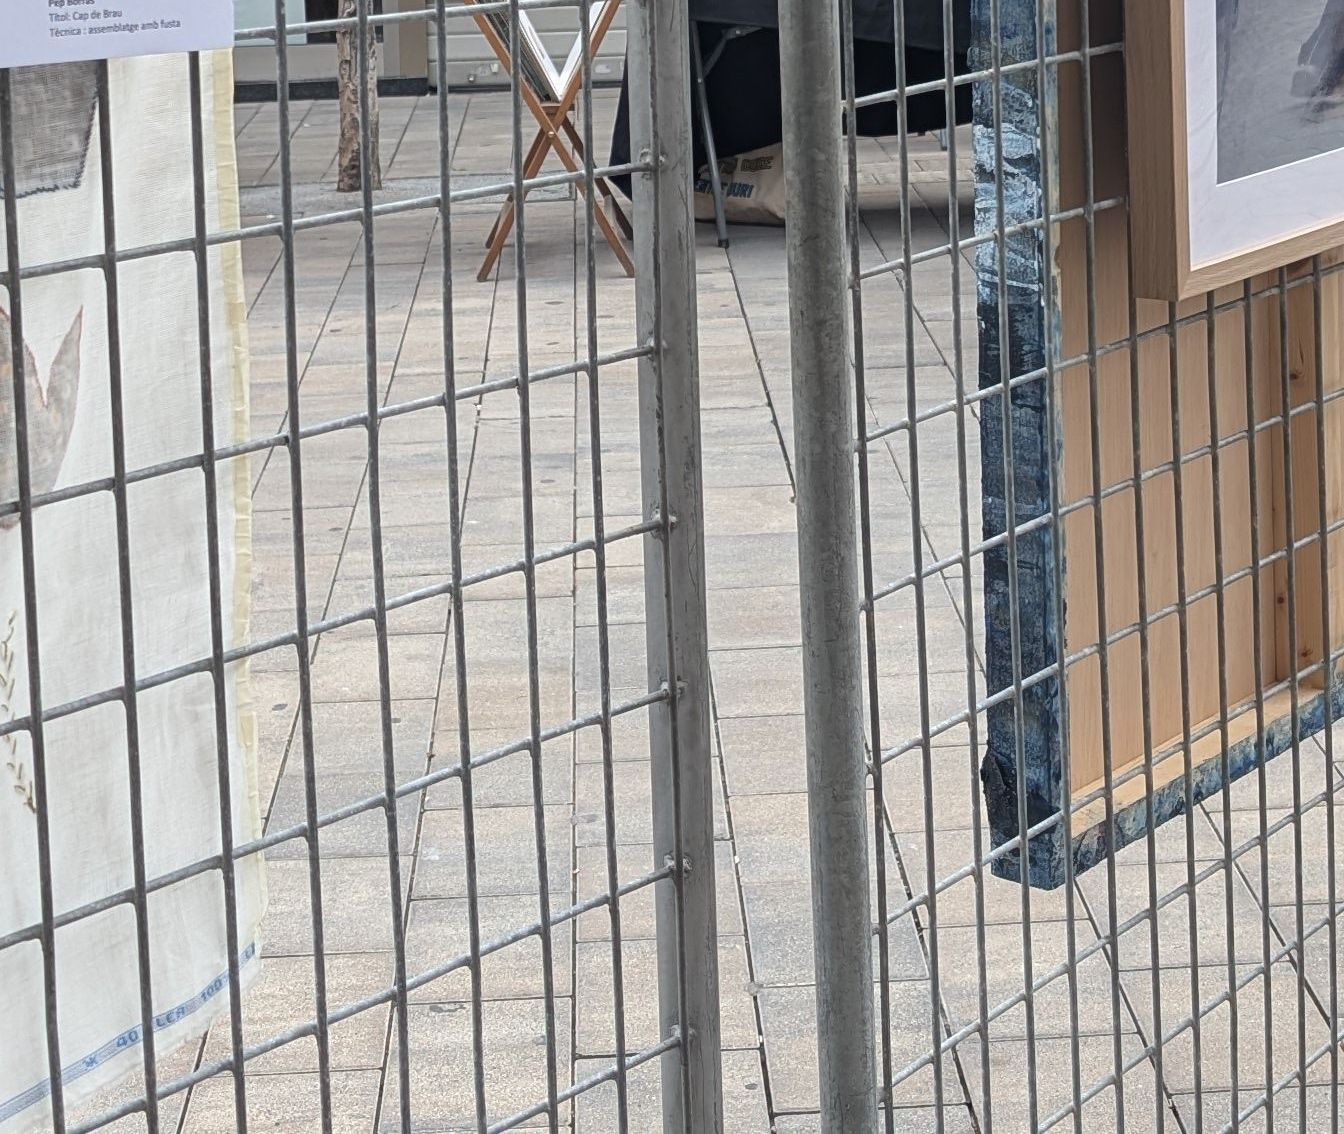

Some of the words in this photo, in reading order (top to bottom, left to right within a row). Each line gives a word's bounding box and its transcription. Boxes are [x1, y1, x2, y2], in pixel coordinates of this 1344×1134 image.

[72, 11, 89, 22] Cap
[90, 10, 102, 20] de
[103, 9, 123, 19] Brau
[141, 21, 158, 31] amb
[160, 19, 181, 29] fusta
